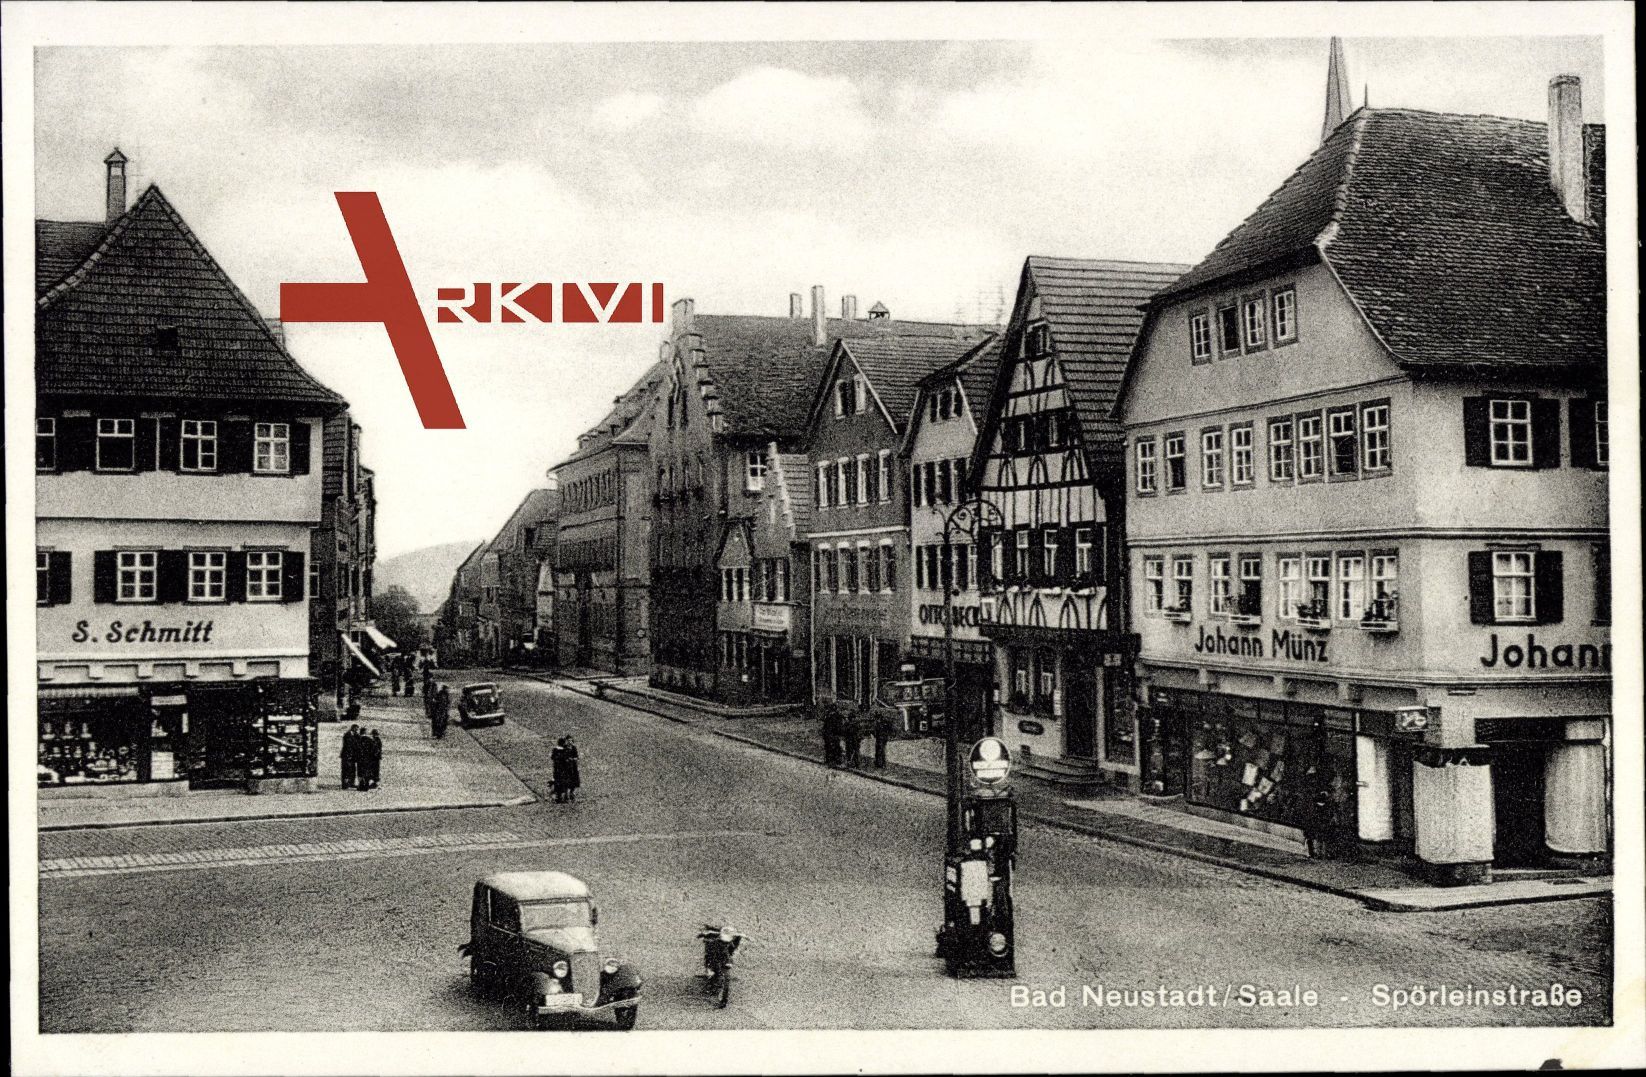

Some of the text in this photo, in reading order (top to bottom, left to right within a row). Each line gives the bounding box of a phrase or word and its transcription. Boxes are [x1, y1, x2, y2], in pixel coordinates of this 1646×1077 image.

[71, 619, 214, 643] S. Schmitt
[1194, 624, 1329, 662] Johann Münz
